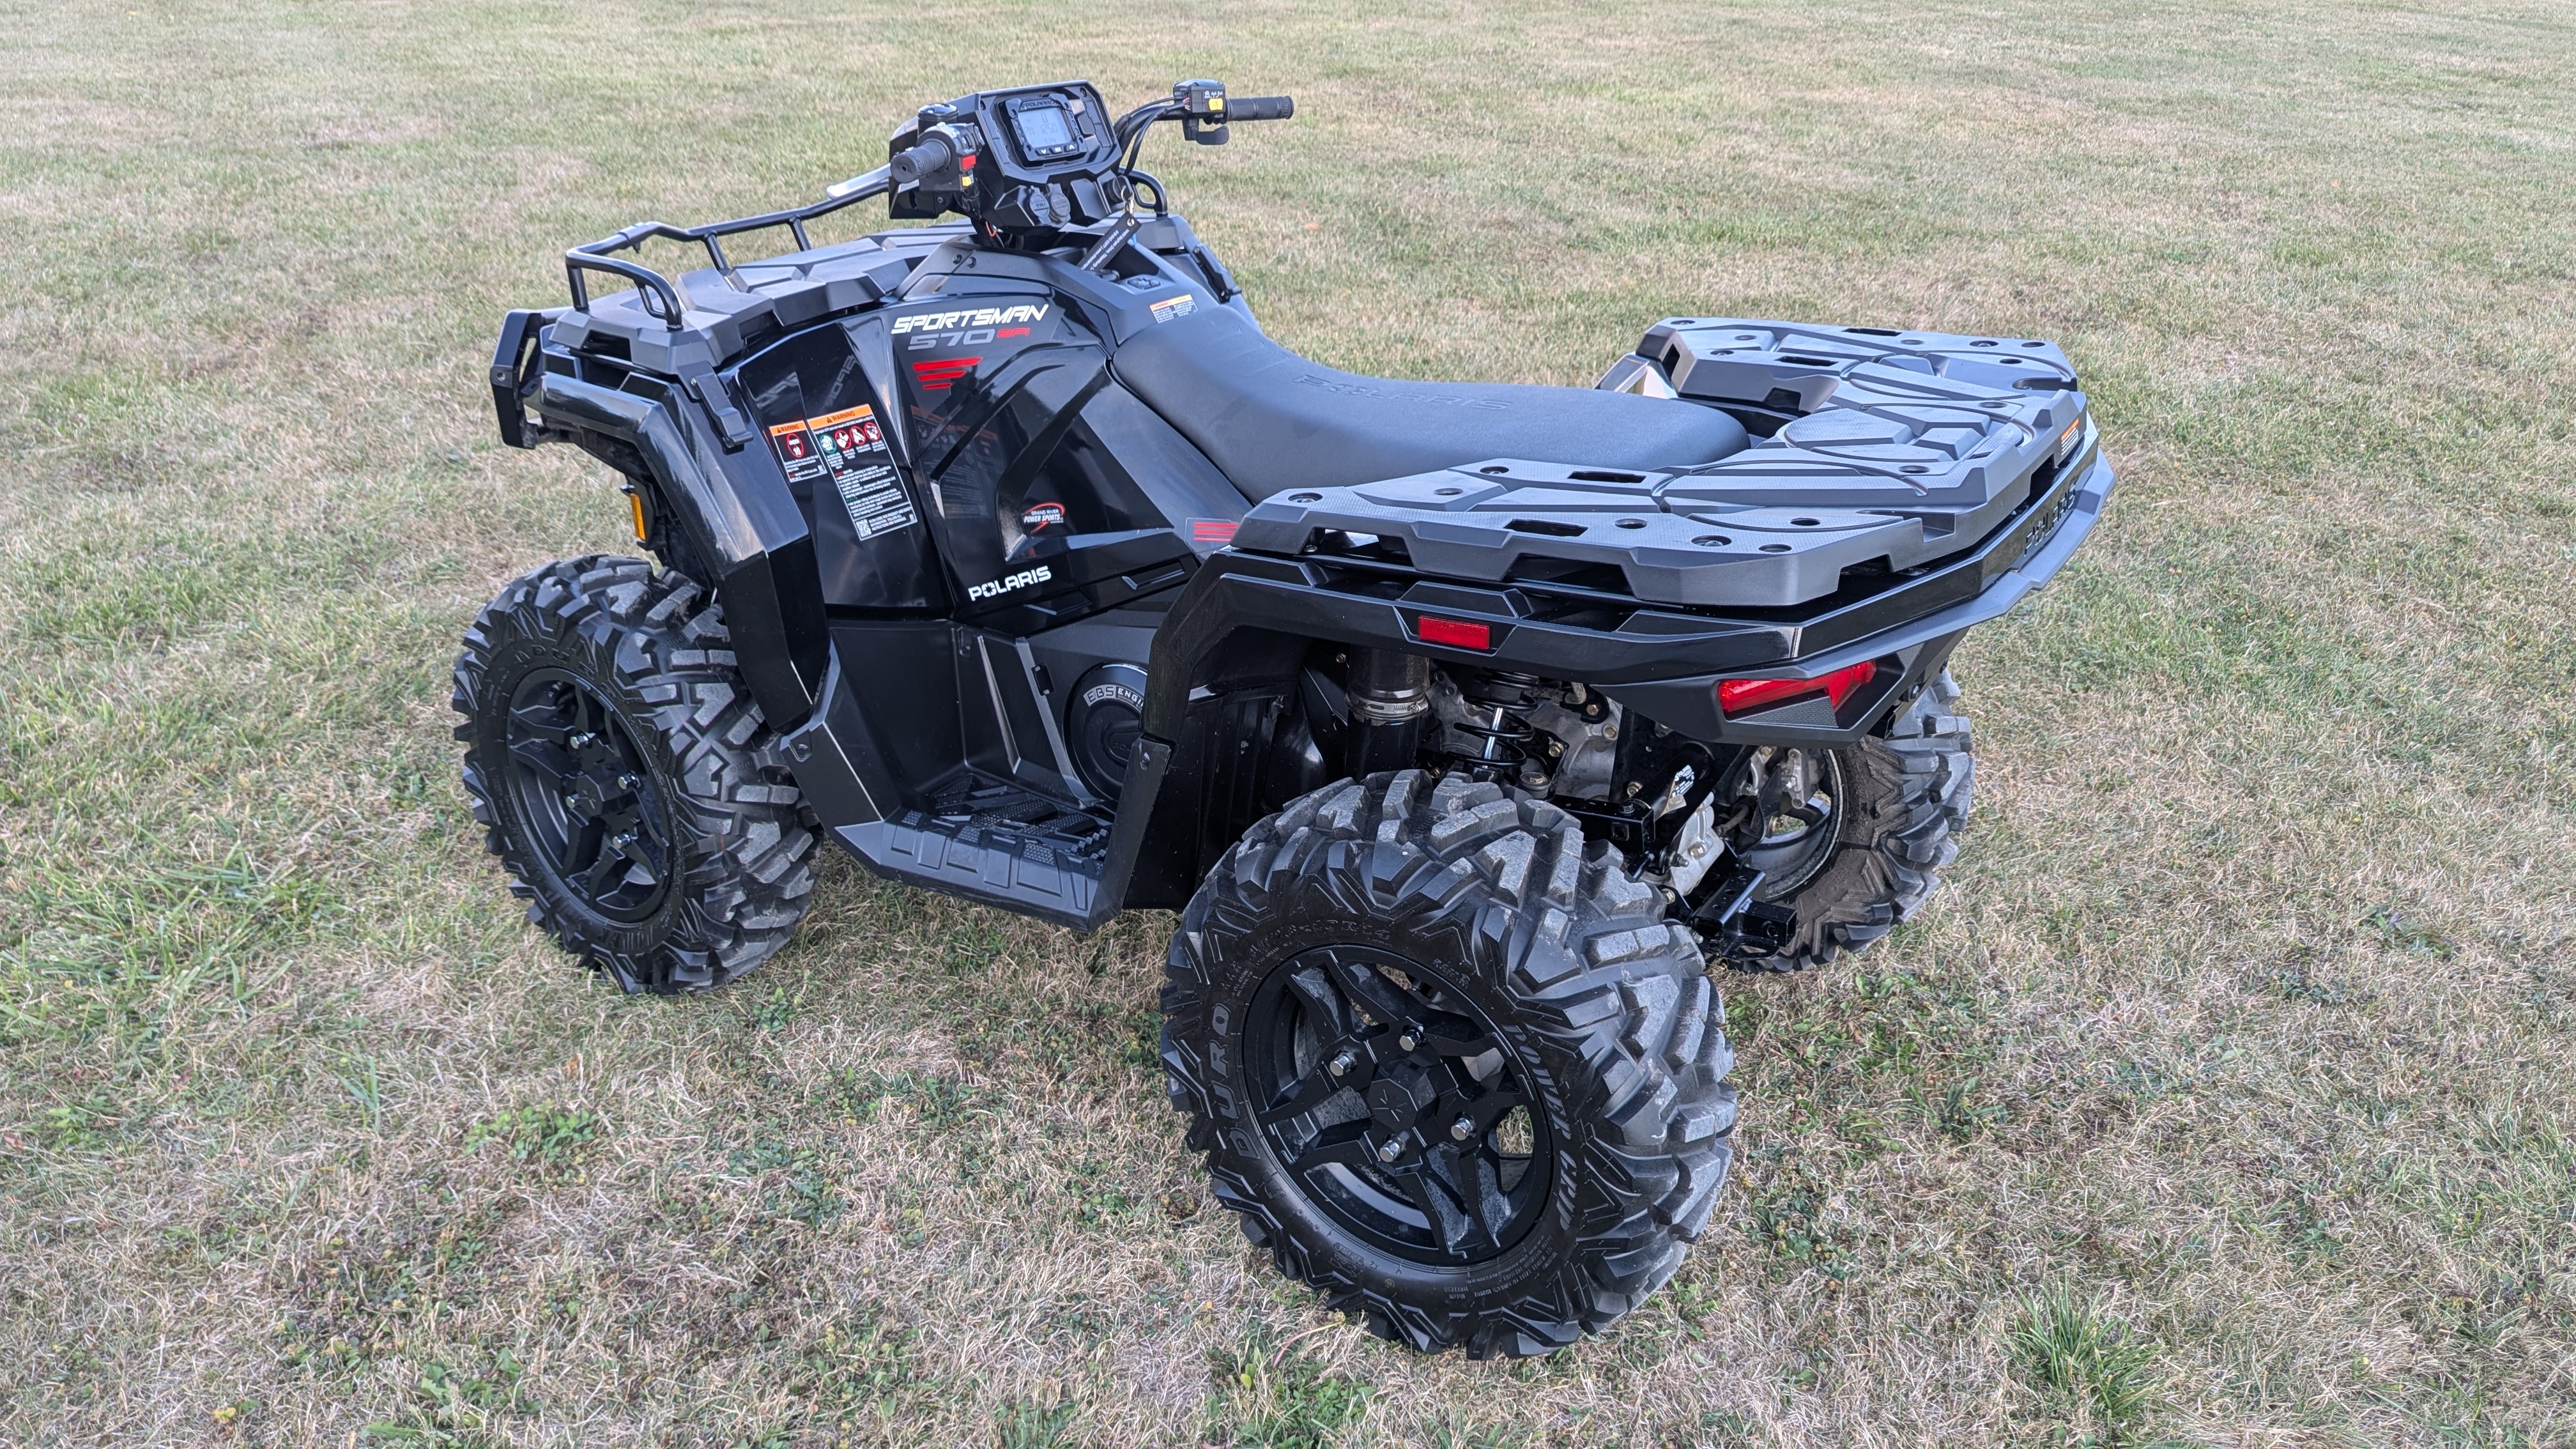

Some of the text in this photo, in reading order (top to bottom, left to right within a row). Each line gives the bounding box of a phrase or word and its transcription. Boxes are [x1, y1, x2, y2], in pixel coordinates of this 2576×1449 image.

[891, 304, 1049, 334] SPORTSMAN
[908, 327, 1031, 351] 570 EFI
[1293, 374, 1513, 411] POLARIS
[781, 424, 800, 432] WARNING
[833, 411, 855, 420] WARNING
[1023, 515, 1041, 523] POWER
[2023, 480, 2076, 557] POLARIS
[968, 565, 1052, 601] POLARIS
[1087, 686, 1114, 703] EBS
[1209, 1002, 1260, 1160] DURO
[1502, 1024, 1577, 1231] POWER GRIP
